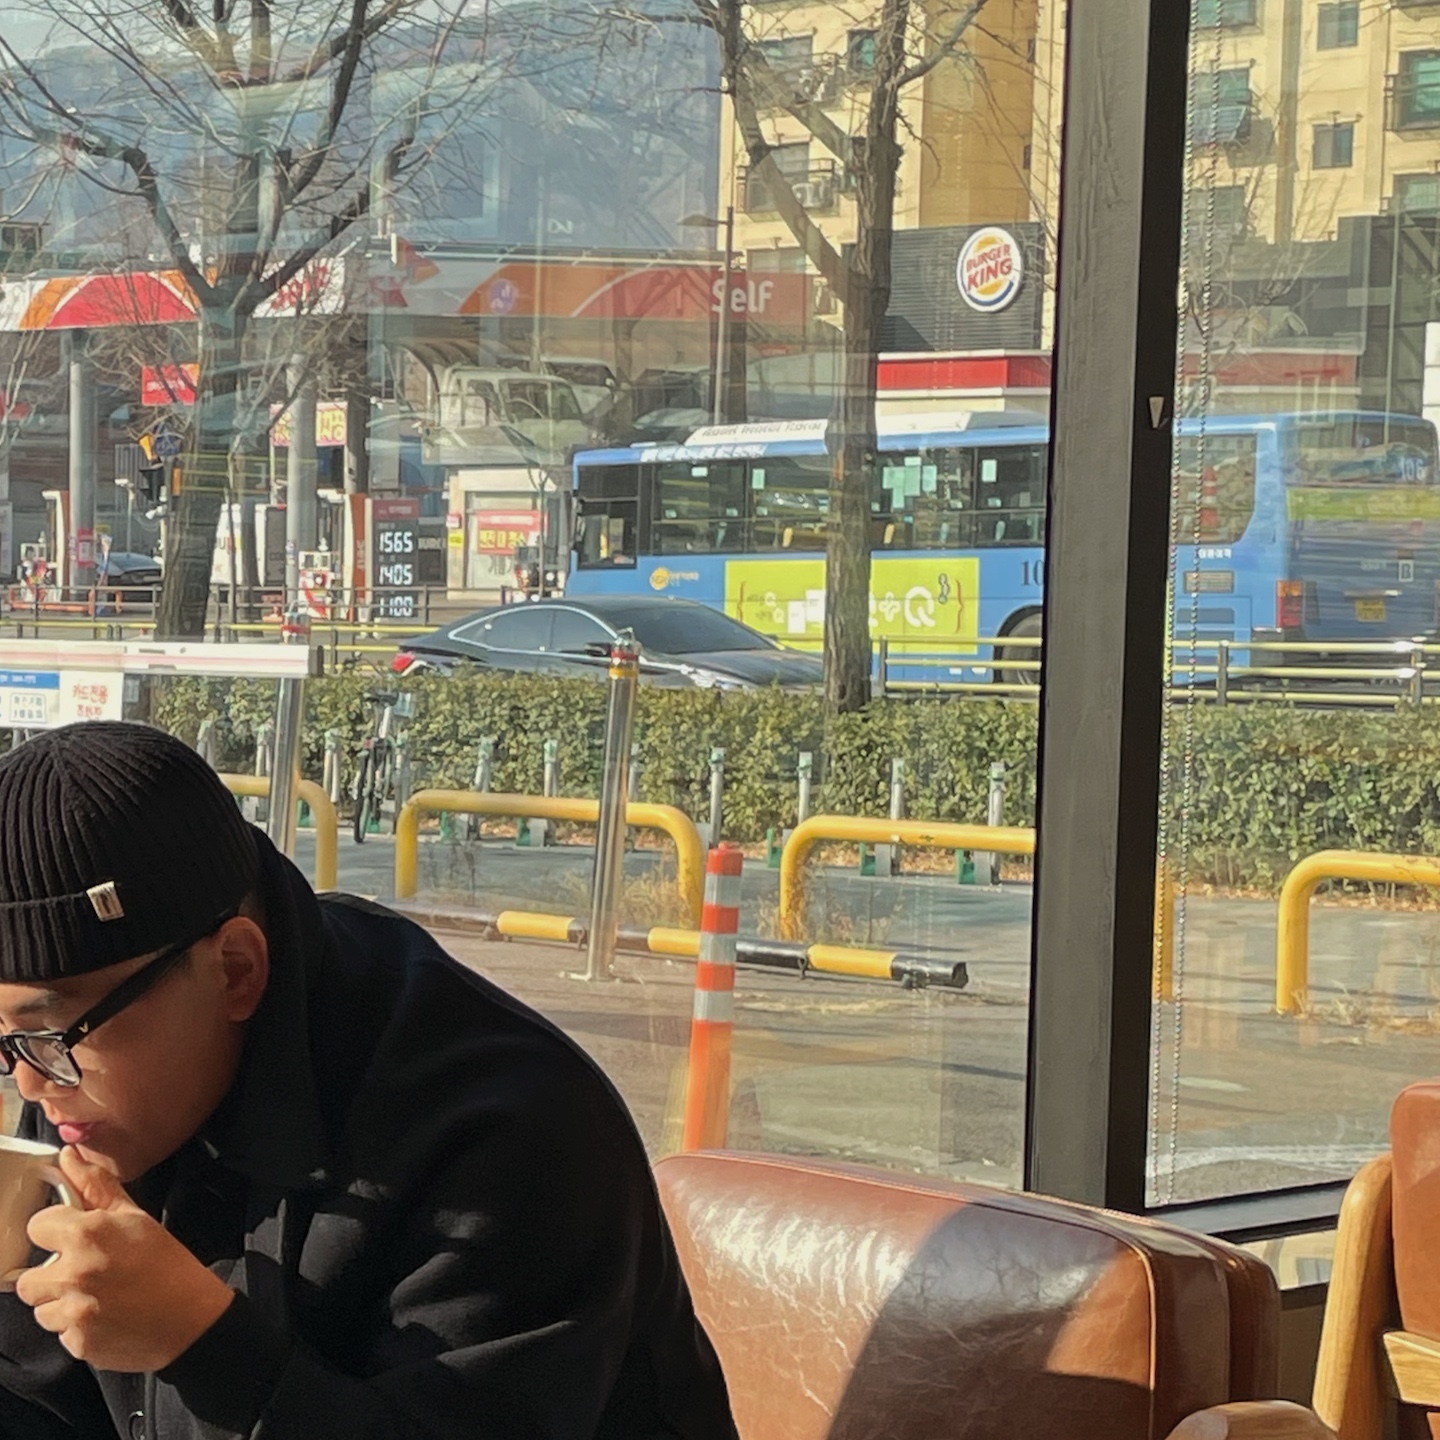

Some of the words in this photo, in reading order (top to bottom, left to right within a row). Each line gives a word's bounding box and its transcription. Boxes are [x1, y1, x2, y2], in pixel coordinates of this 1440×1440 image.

[966, 244, 1012, 273] BURGER
[967, 258, 1012, 291] KING
[711, 278, 774, 314] Self
[379, 531, 413, 553] 1565
[379, 564, 413, 586] 1405
